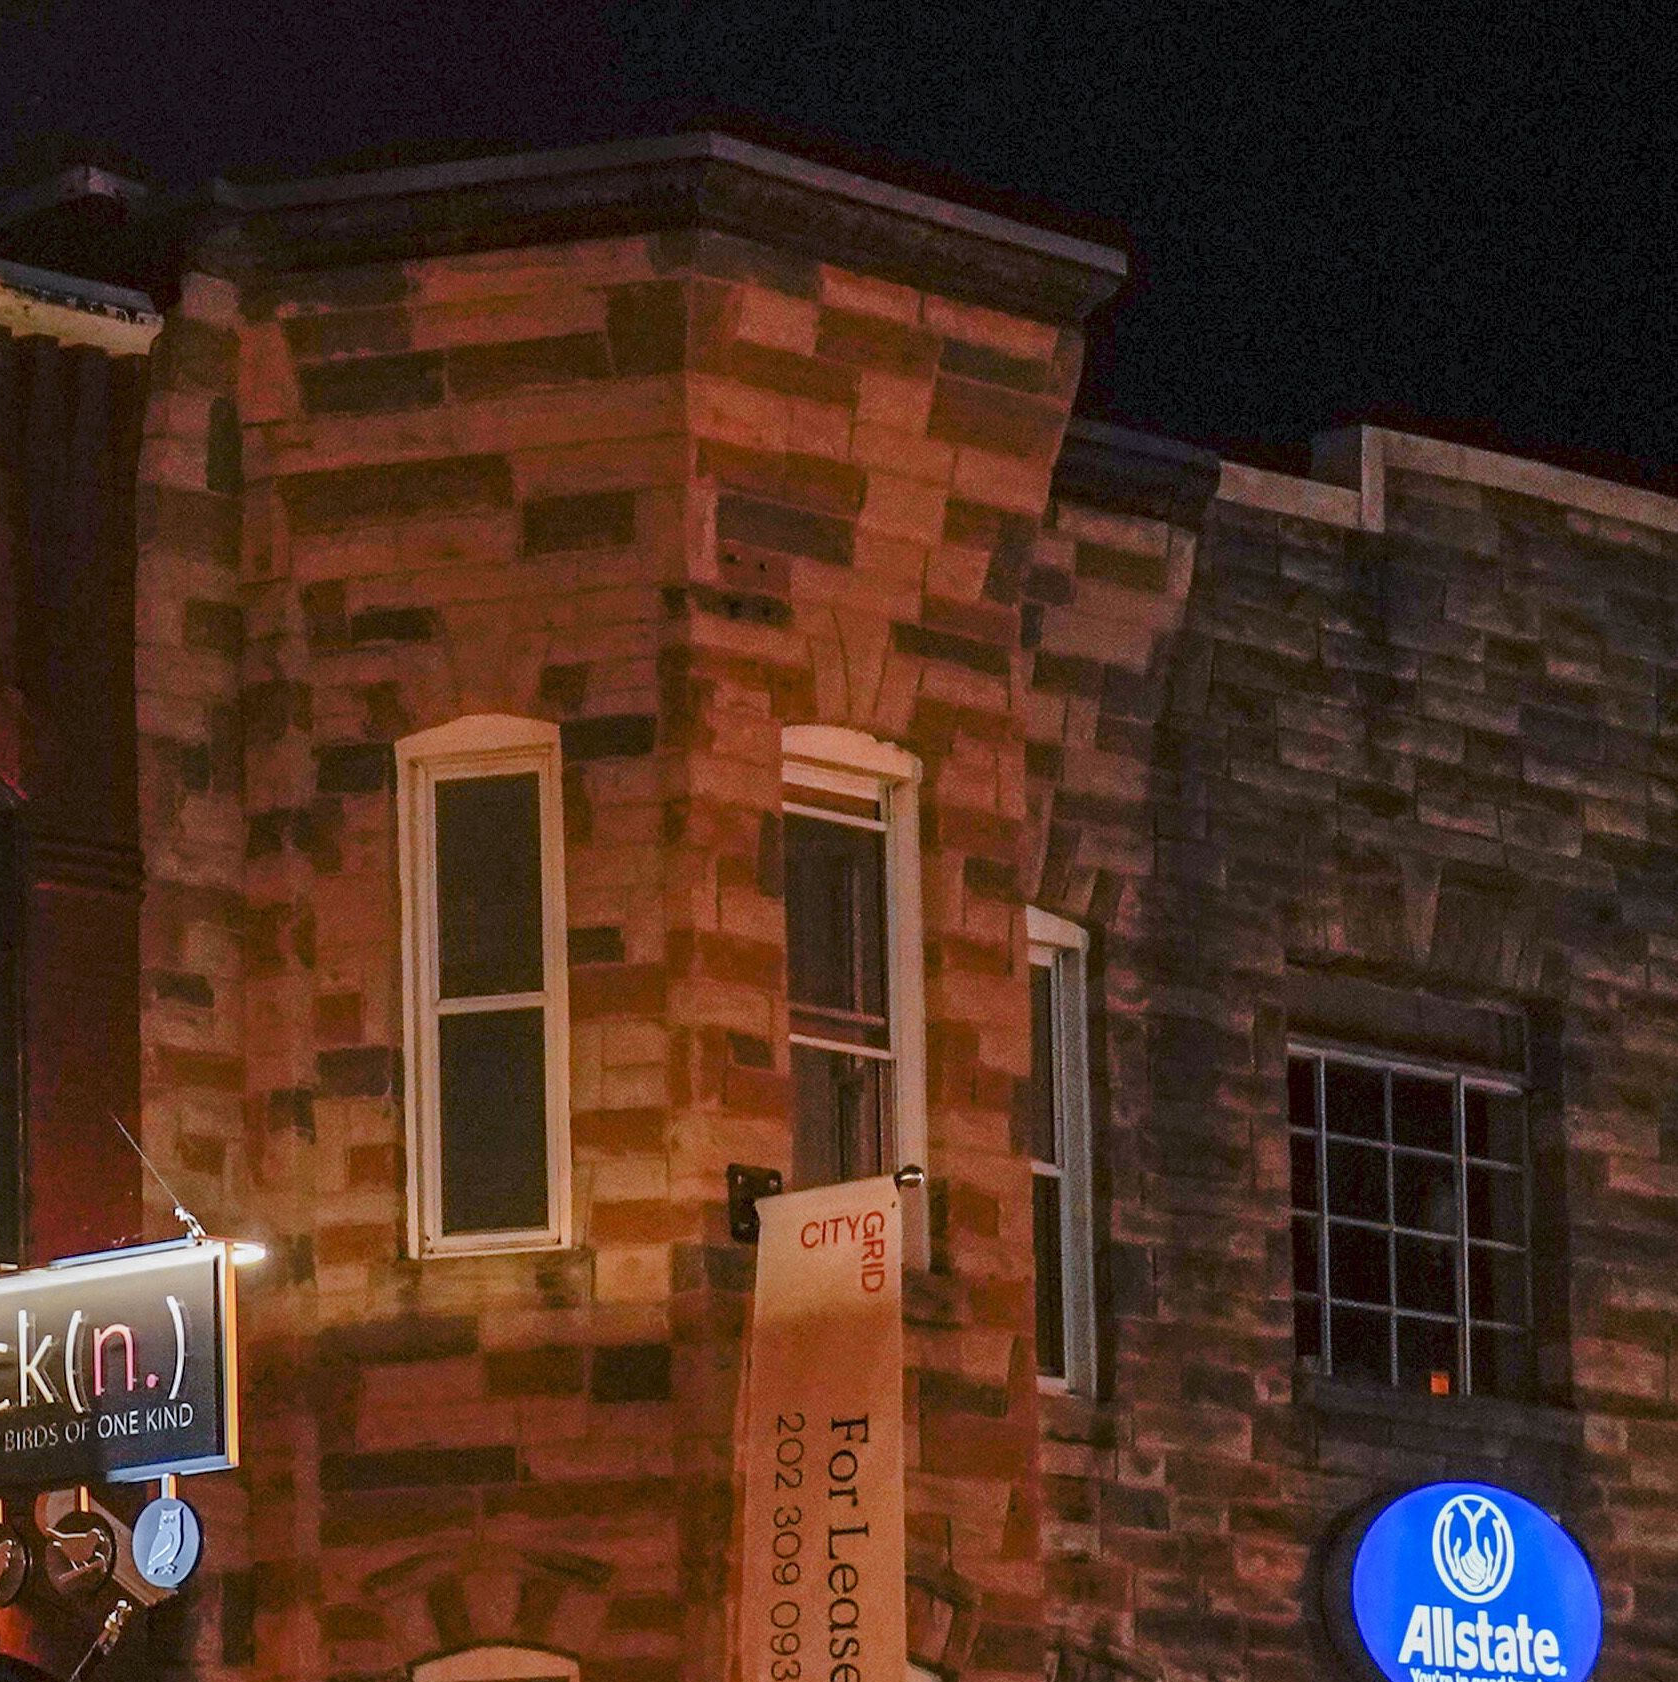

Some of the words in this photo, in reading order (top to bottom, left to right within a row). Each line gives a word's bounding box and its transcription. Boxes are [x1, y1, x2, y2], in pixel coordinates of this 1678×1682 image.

[800, 1213, 862, 1250] CITY
[860, 1210, 885, 1294] GRID
[4, 1423, 59, 1453] BIRDS
[65, 1418, 91, 1443] OF
[96, 1410, 140, 1440] ONE
[145, 1401, 195, 1432] KIND
[774, 1411, 806, 1491] 202
[827, 1413, 870, 1508] For
[771, 1505, 803, 1587] 309
